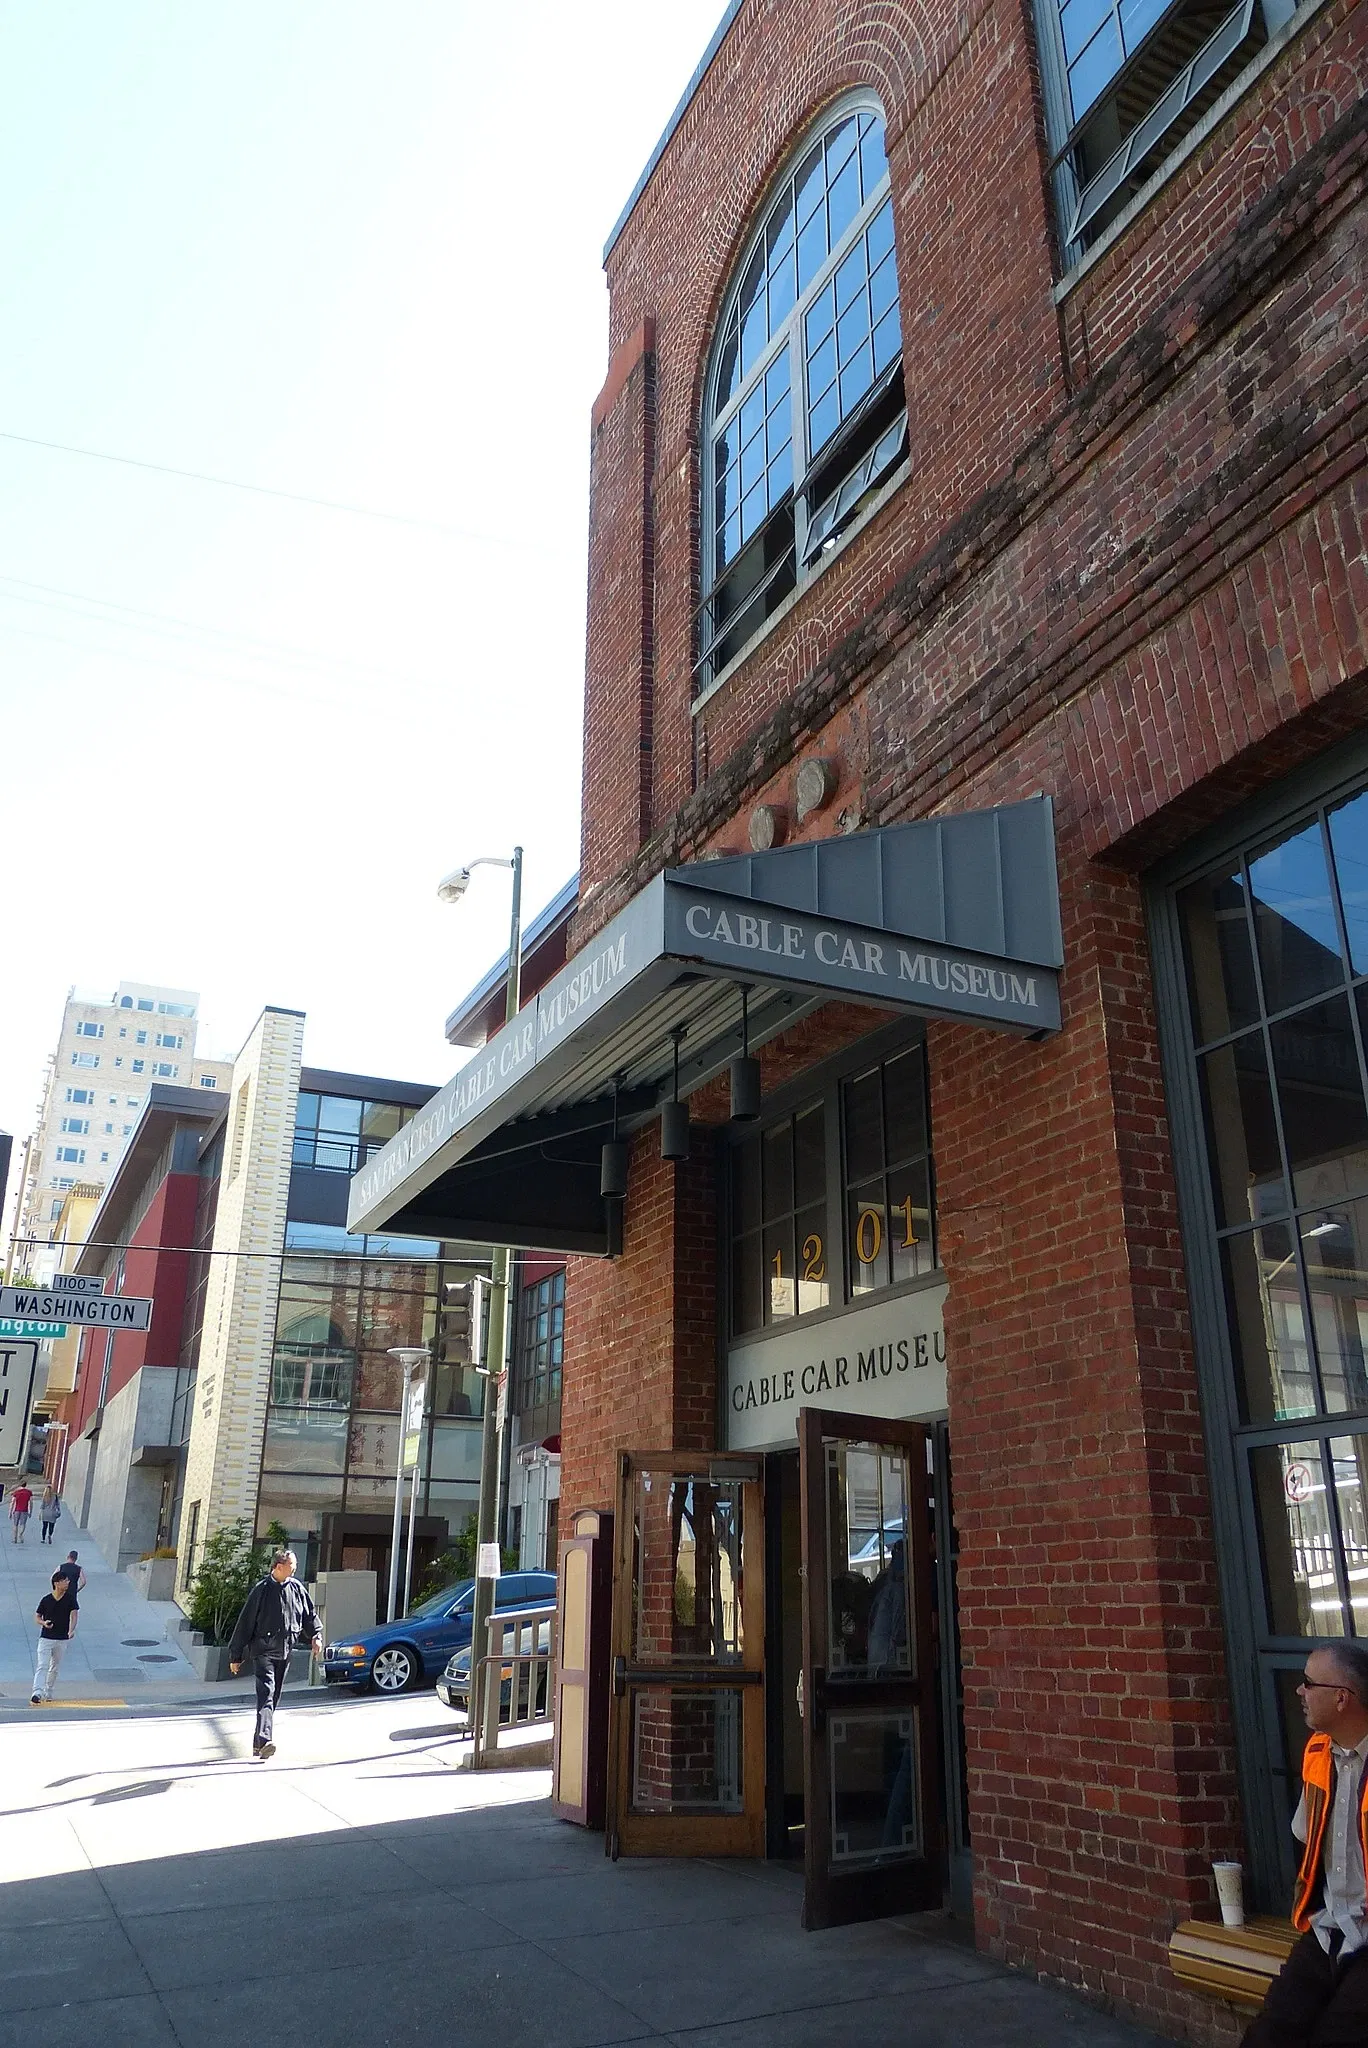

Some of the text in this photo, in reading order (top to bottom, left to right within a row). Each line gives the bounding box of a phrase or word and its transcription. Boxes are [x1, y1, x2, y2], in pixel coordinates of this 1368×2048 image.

[685, 905, 1039, 1008] CABLE CAR MUSEUM
[359, 931, 628, 1208] SAN FRANCISCO CABLE CAR MUSEUM
[772, 1195, 919, 1291] 1201
[15, 1294, 136, 1323] WASHINGTON
[58, 1277, 86, 1290] 1100
[731, 1370, 795, 1412] CABLE
[801, 1356, 849, 1395] CAR
